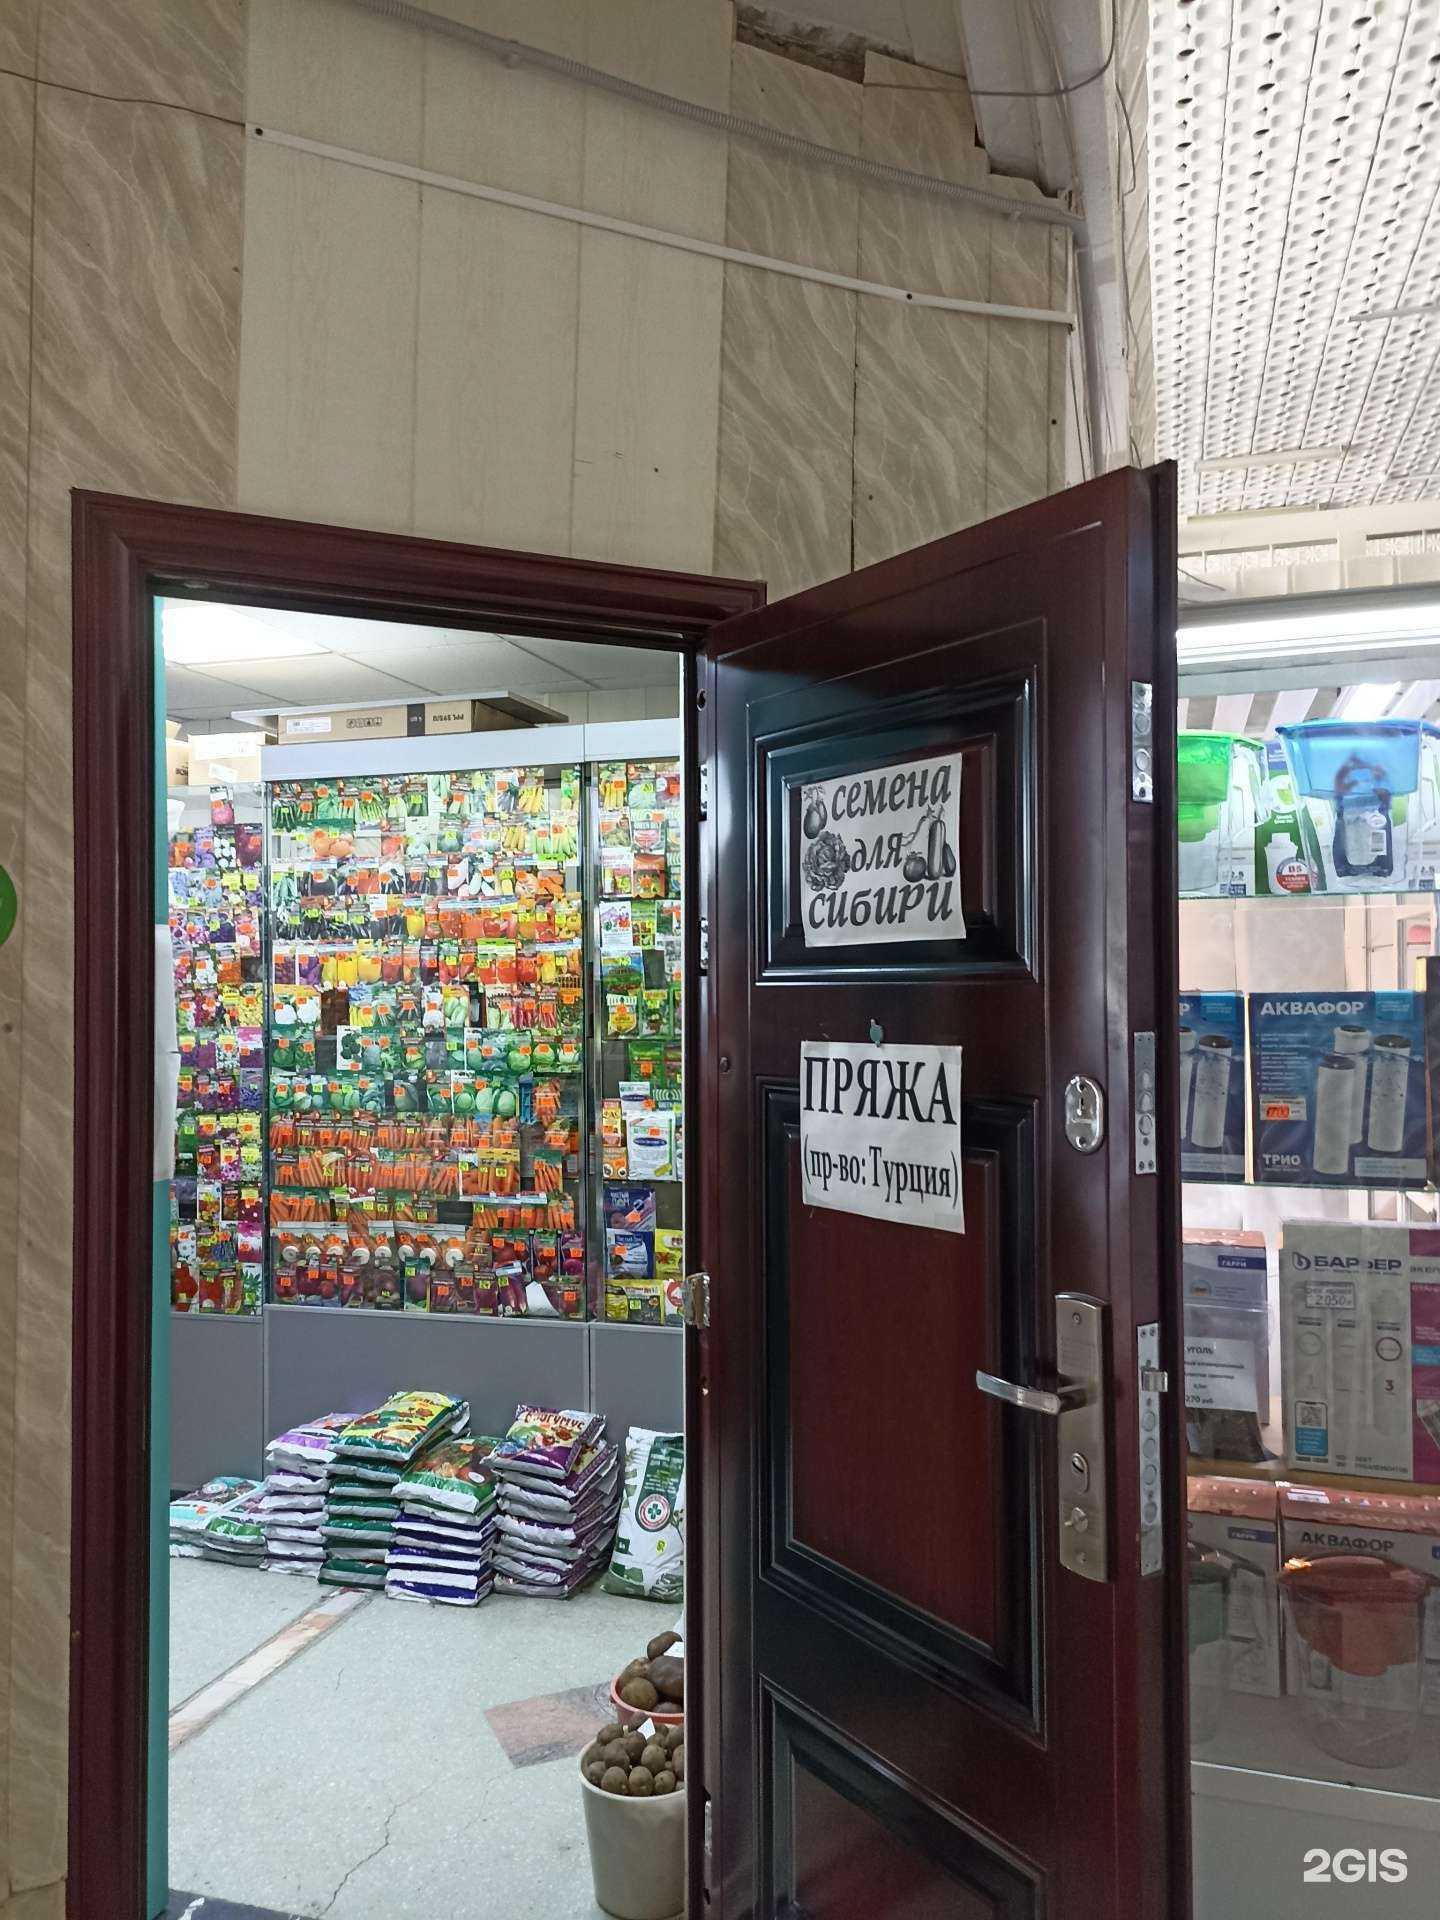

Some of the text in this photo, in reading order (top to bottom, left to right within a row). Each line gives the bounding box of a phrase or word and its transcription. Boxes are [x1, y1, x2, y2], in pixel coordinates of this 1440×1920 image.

[831, 764, 952, 821] семена
[851, 832, 903, 872] для
[808, 880, 953, 930] сибири
[1260, 1001, 1364, 1016] АКВАФОР
[803, 1056, 958, 1126] ПРЯЖА
[1262, 1154, 1300, 1166] ТРИО
[1302, 1531, 1395, 1552] АКВАФОР
